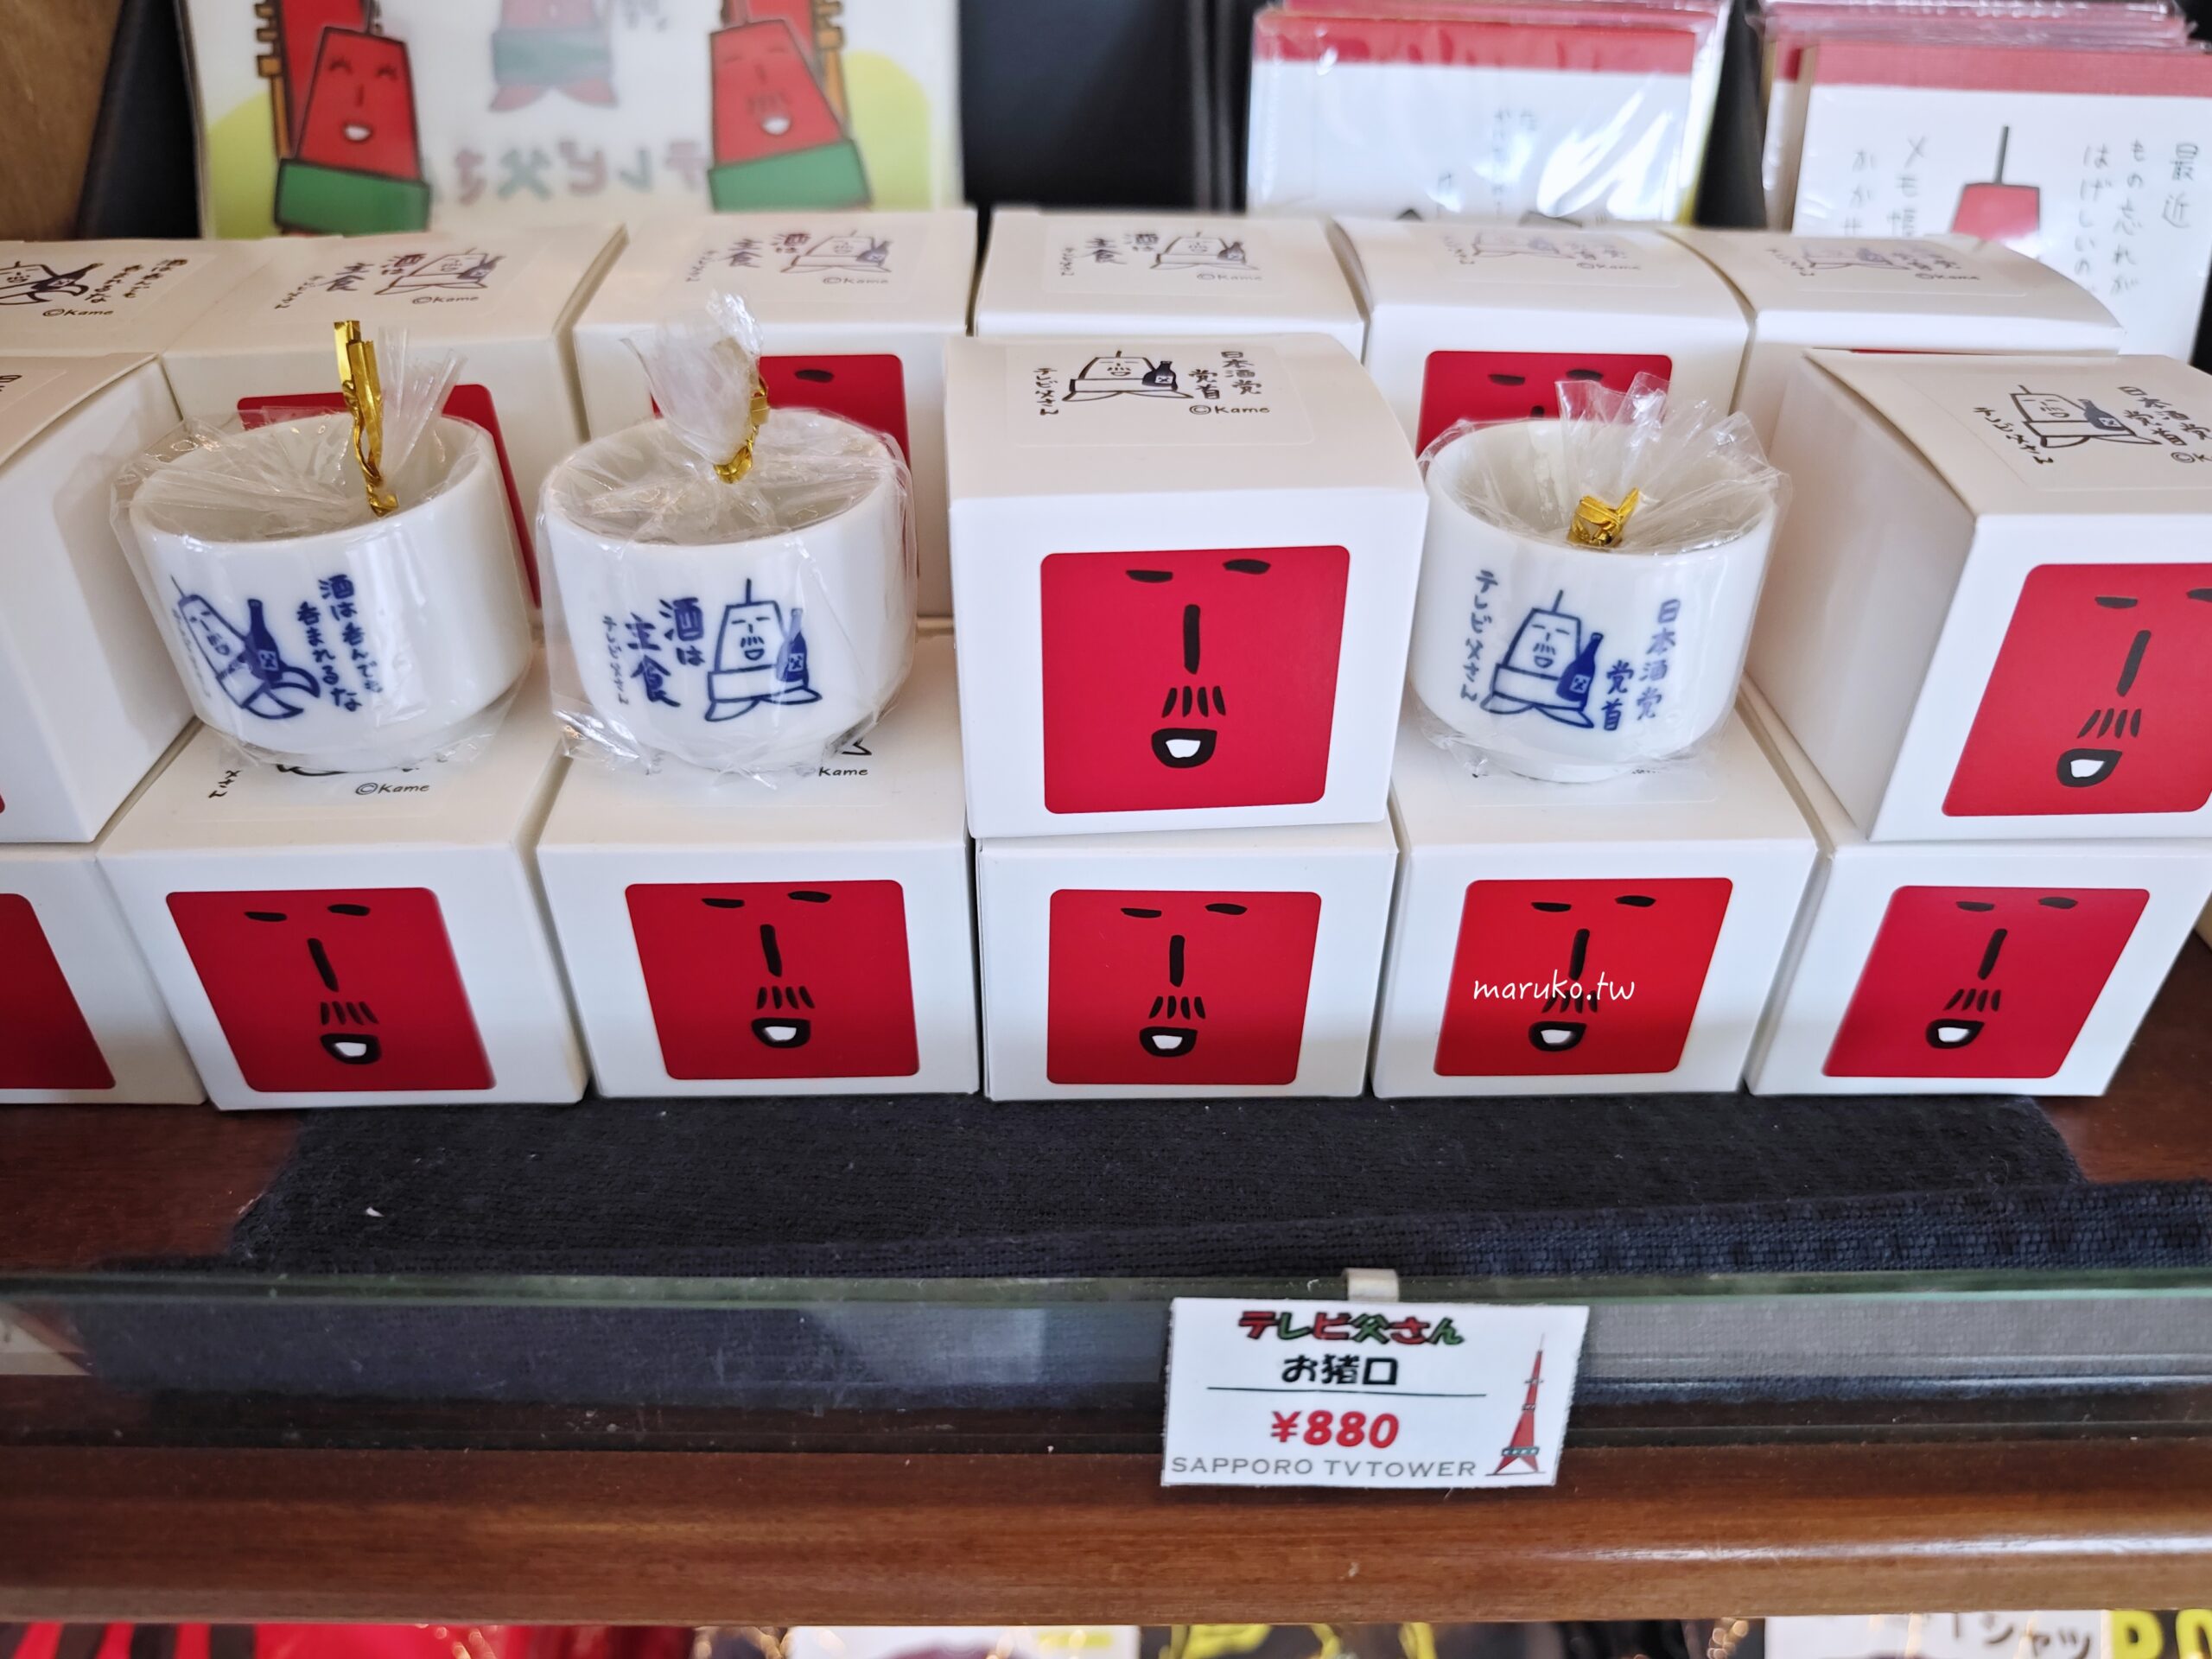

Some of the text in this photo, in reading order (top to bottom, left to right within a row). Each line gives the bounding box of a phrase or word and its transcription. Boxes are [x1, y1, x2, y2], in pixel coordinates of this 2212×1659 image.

[2074, 143, 2112, 291] はげしいの
[2161, 143, 2199, 229] 最近
[1189, 369, 1220, 400] 党首
[1220, 351, 1262, 396] 日本酒党
[296, 601, 363, 712] 呑まれるな
[625, 611, 681, 708] 主食
[658, 596, 706, 666] 酒は
[1460, 570, 1498, 702] テレビ父さん
[1636, 599, 1681, 721] 日本酒党
[1601, 659, 1635, 731] 党首
[1238, 1311, 1465, 1345] テレビ父さん
[1281, 1354, 1399, 1386] お猪口
[1271, 1410, 1400, 1449] ¥880
[1171, 1457, 1313, 1475] SAPPORO
